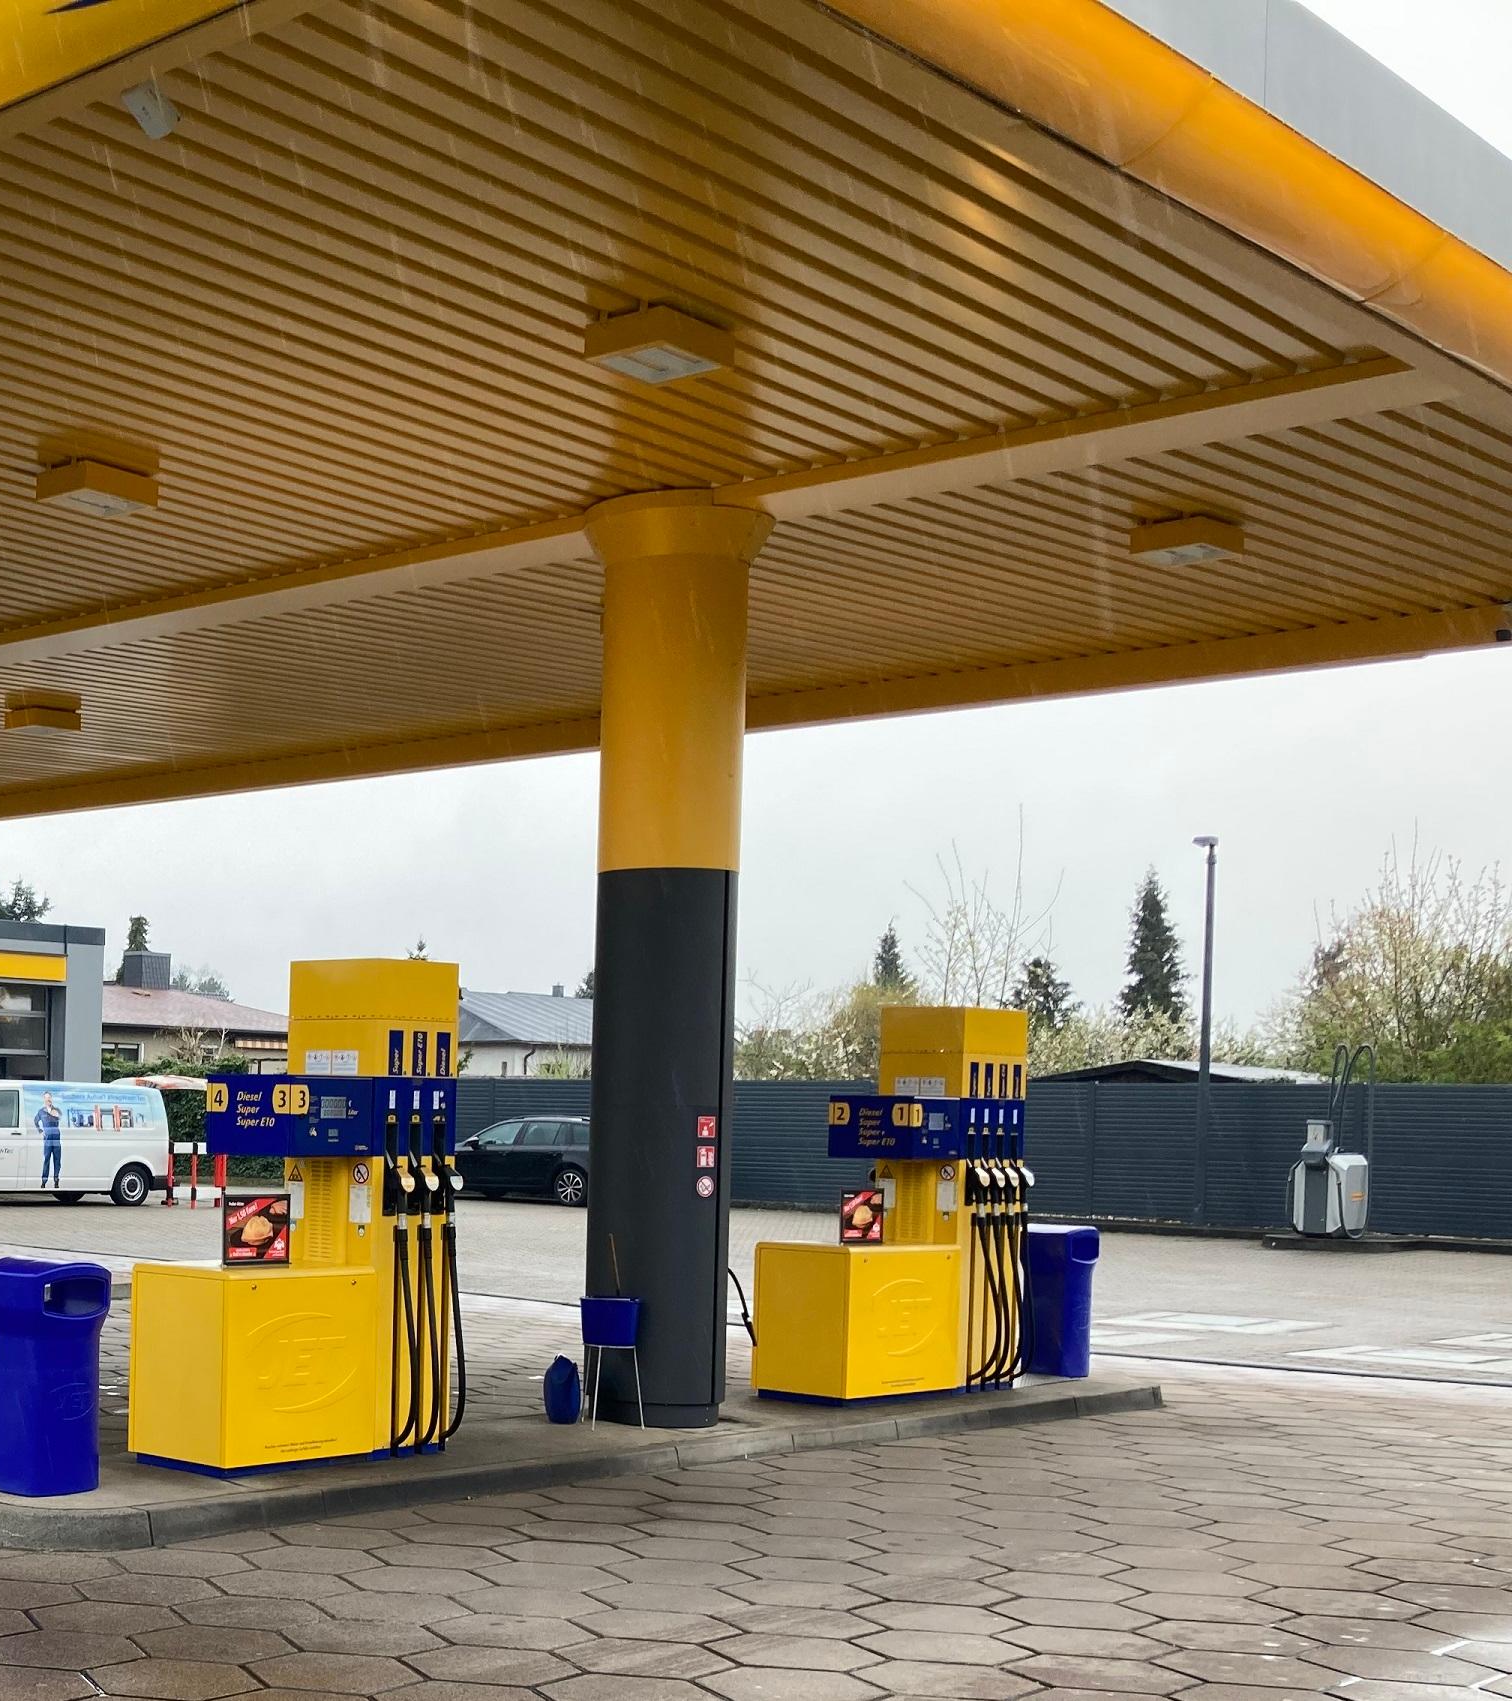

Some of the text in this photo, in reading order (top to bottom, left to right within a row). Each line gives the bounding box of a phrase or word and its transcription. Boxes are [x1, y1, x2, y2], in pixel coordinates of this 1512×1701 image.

[392, 1048, 401, 1074] Super
[416, 1050, 424, 1075] Super
[214, 1089, 224, 1107] 4
[236, 1091, 262, 1101] Diesel
[278, 1090, 286, 1108] 3
[298, 1090, 306, 1108] 3
[236, 1103, 260, 1114] Super
[836, 1107, 845, 1121] 2
[897, 1107, 905, 1121] 1
[236, 1117, 276, 1129] Super E10
[915, 1109, 920, 1123] 1
